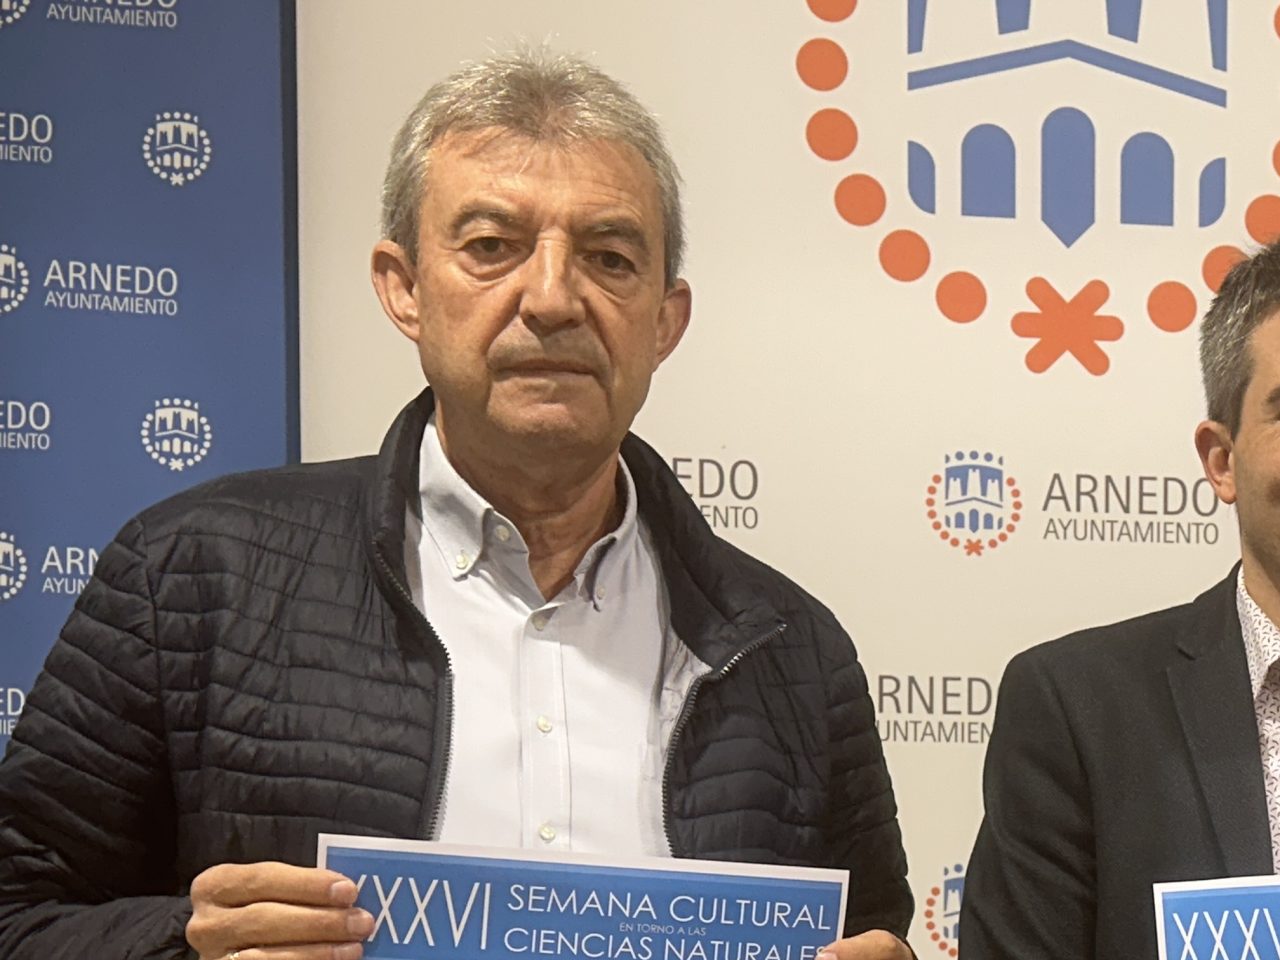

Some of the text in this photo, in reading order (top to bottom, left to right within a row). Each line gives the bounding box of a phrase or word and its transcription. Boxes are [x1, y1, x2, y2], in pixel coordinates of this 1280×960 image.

[47, 4, 176, 27] AYUNTAMIENTO
[44, 260, 178, 296] ARNEDO
[45, 291, 177, 315] AYUNTAMIENTO
[1042, 473, 1219, 517] ARNEDO
[1042, 519, 1219, 545] AYUNTAMIENTO
[357, 874, 491, 950] XXVI
[507, 884, 832, 930] SEMANA CULTURAL
[503, 927, 653, 960] CIENCIAS
[619, 923, 706, 936] EN TORNO A LAS
